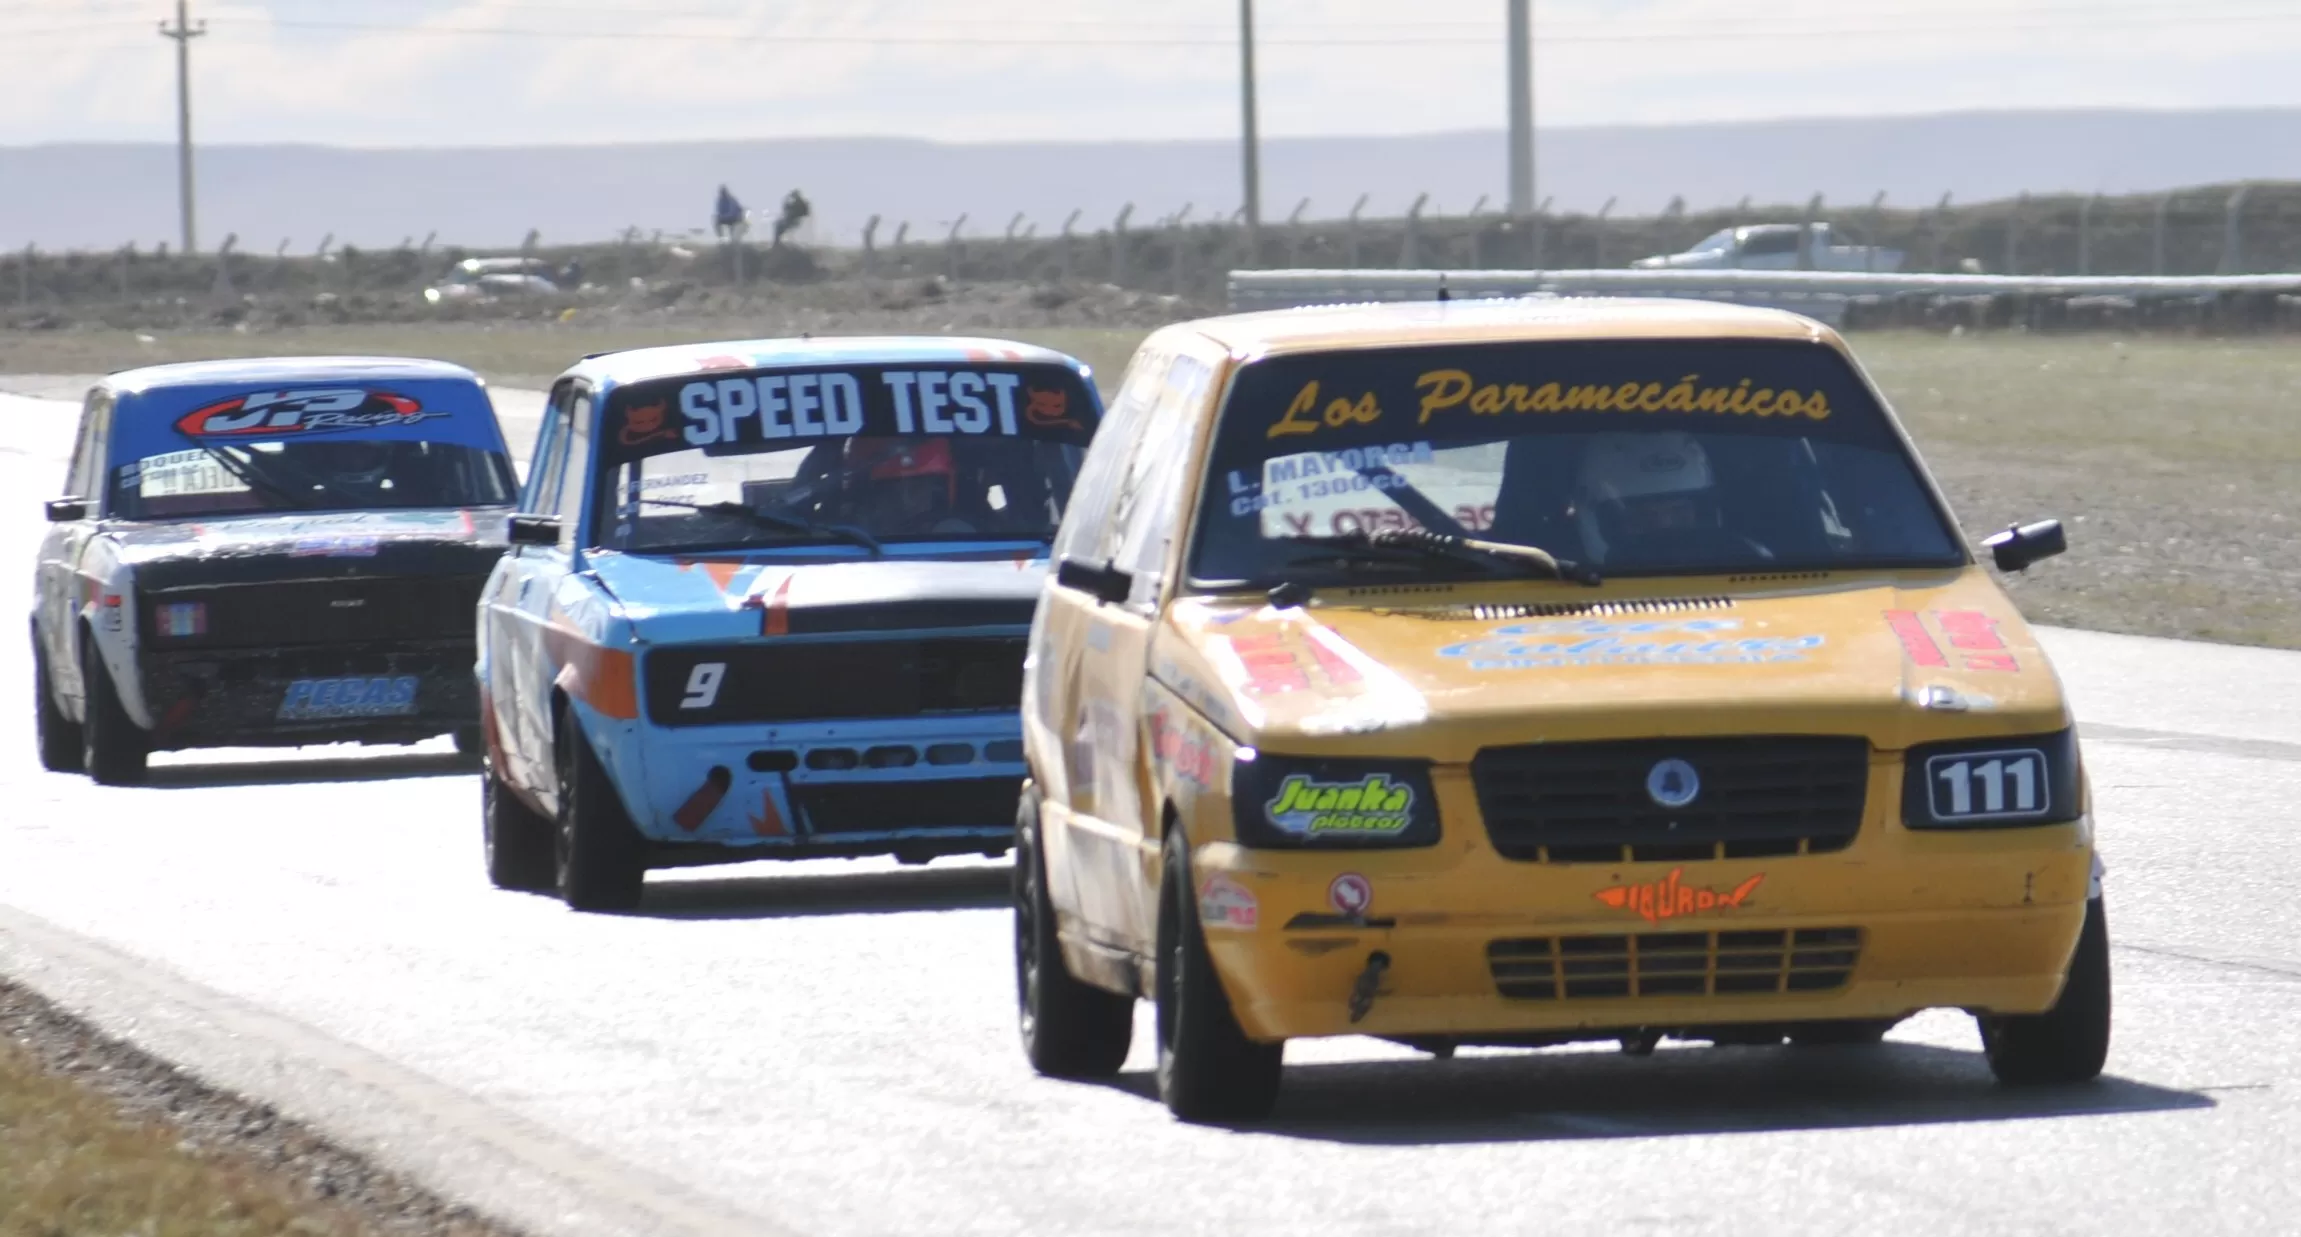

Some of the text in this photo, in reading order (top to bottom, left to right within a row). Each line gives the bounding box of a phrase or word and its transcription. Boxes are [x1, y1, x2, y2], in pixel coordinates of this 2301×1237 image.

[304, 410, 452, 431] Racing
[678, 371, 1020, 446] SPEED TEST
[1268, 369, 1832, 438] Los Paramecánicos
[1228, 440, 1435, 494] L. MAYORGA
[1231, 474, 1408, 517] Cat. 1300cc
[680, 662, 727, 708] 9
[1272, 779, 1407, 814] Juanka
[1939, 757, 2034, 813] 111
